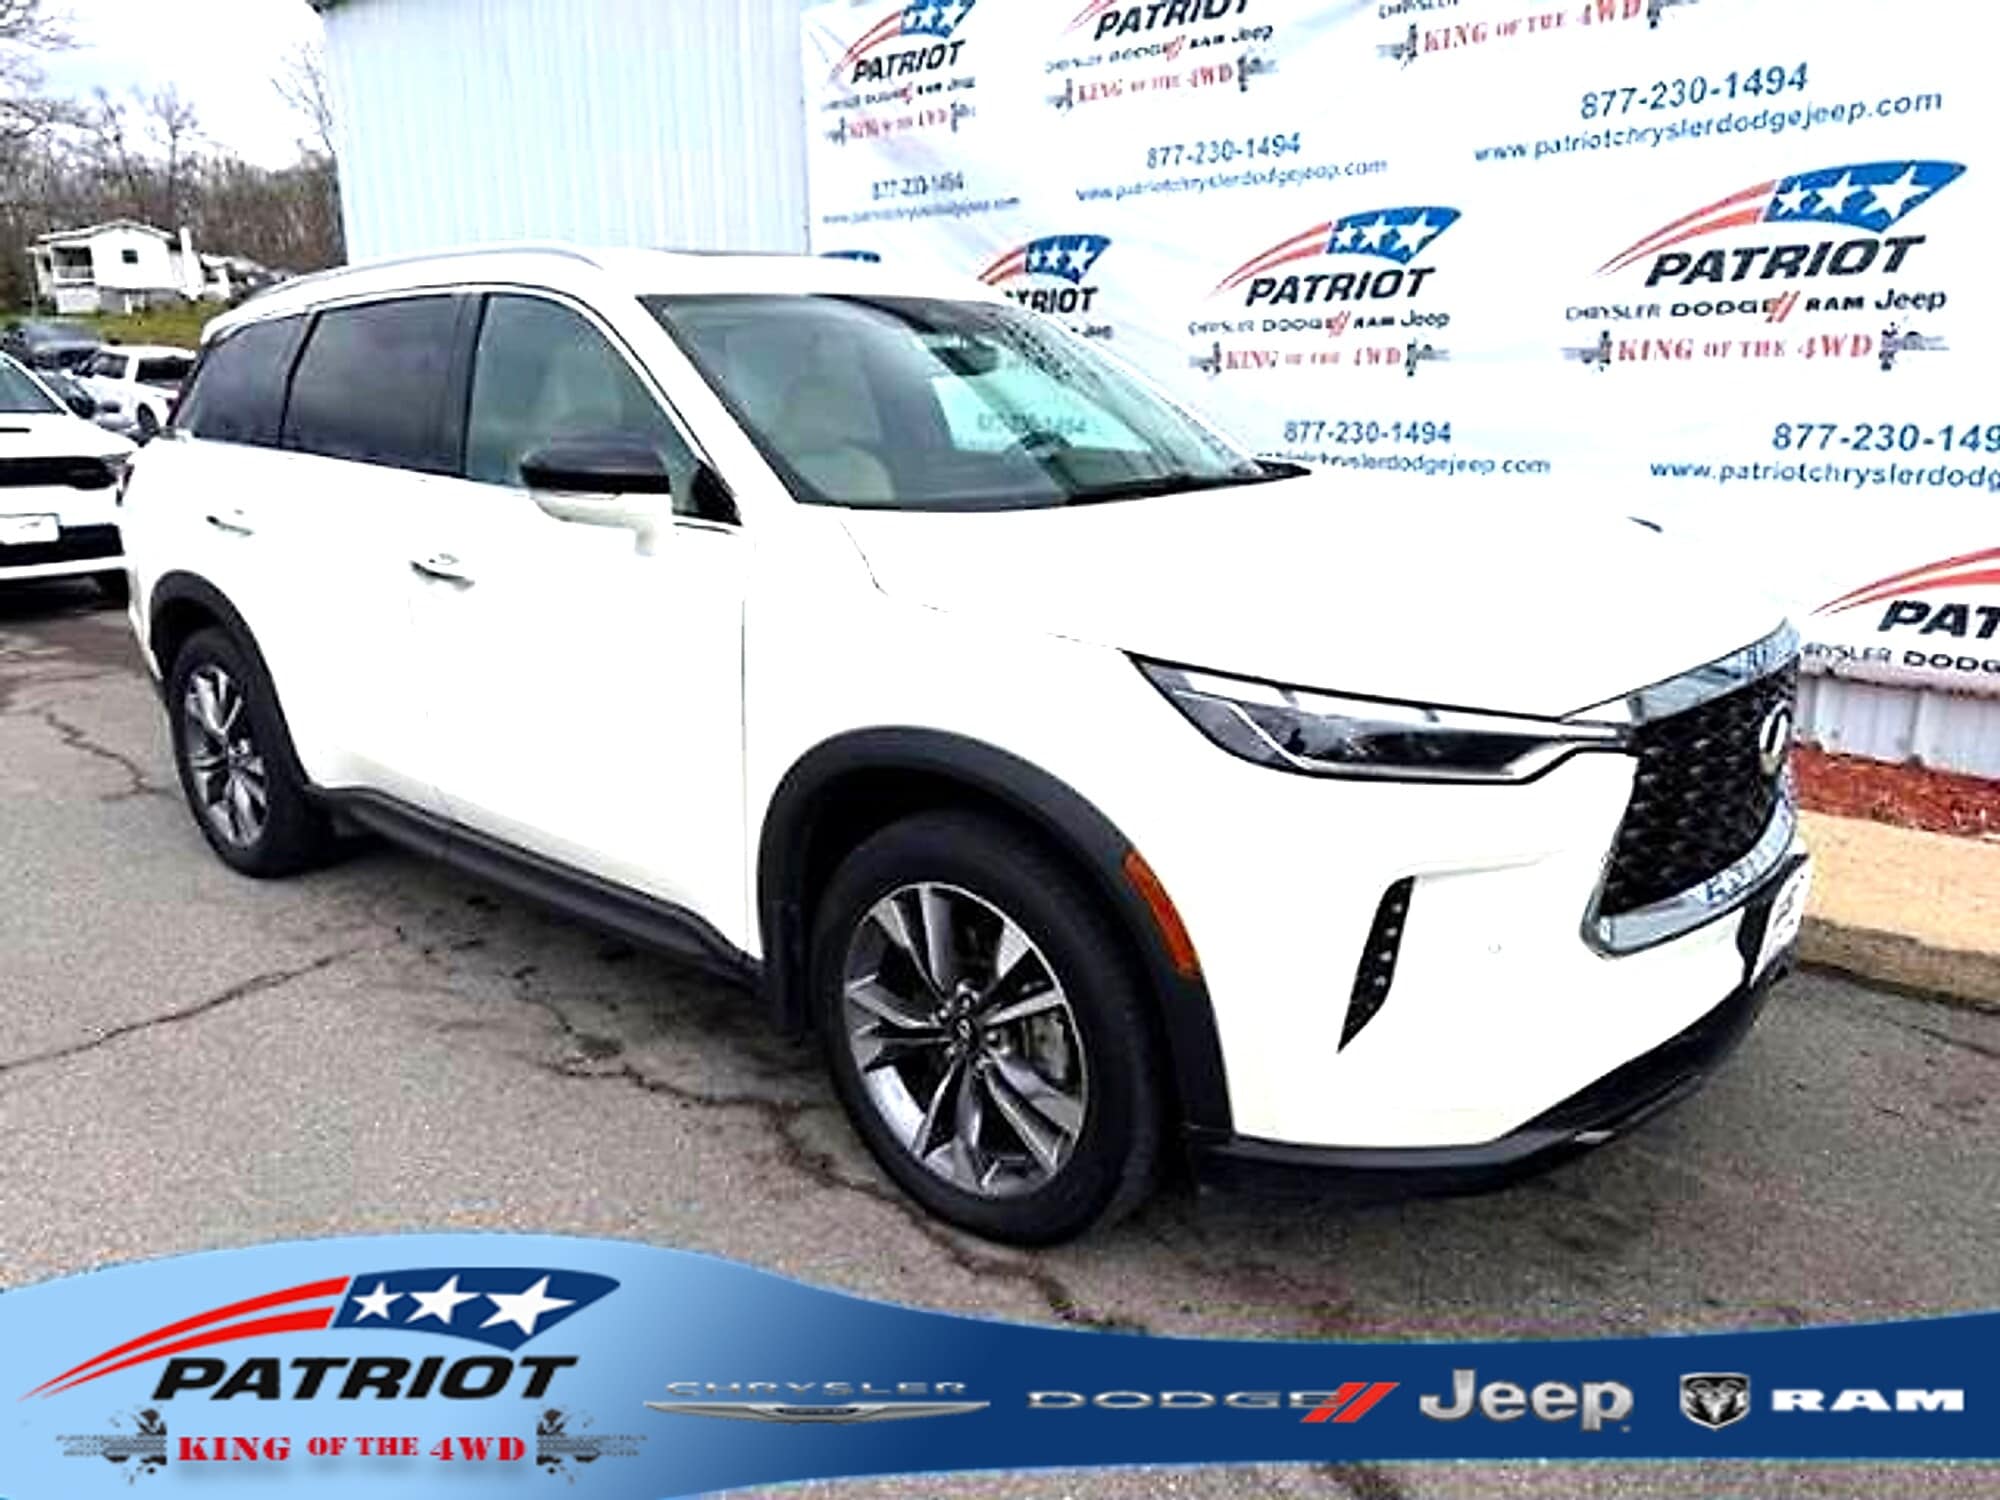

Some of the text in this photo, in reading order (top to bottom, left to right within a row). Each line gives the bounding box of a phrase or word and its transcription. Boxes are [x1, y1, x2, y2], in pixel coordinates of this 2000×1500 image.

[1424, 22, 1488, 53] KING
[851, 39, 966, 84] PATRIOT
[1580, 62, 1810, 120] 877-230-1494
[1474, 90, 1943, 162] www.patriotchryslerdodgejeep.com
[1147, 132, 1301, 169] 877-230-1494
[1645, 234, 1927, 288] PATRIOT
[1005, 285, 1099, 314] TRIOT
[1245, 266, 1437, 307] PATRIOT
[1400, 309, 1451, 329] Jeep
[1565, 304, 1661, 323] CHRYSLER
[1805, 297, 1865, 312] RAM
[1875, 289, 1947, 311] Jeep
[1618, 334, 1873, 362] KING OF THE 4WD
[1284, 420, 1452, 444] 877-230-1494
[1772, 422, 2000, 453] 877-230-149
[1877, 600, 2000, 639] PAT
